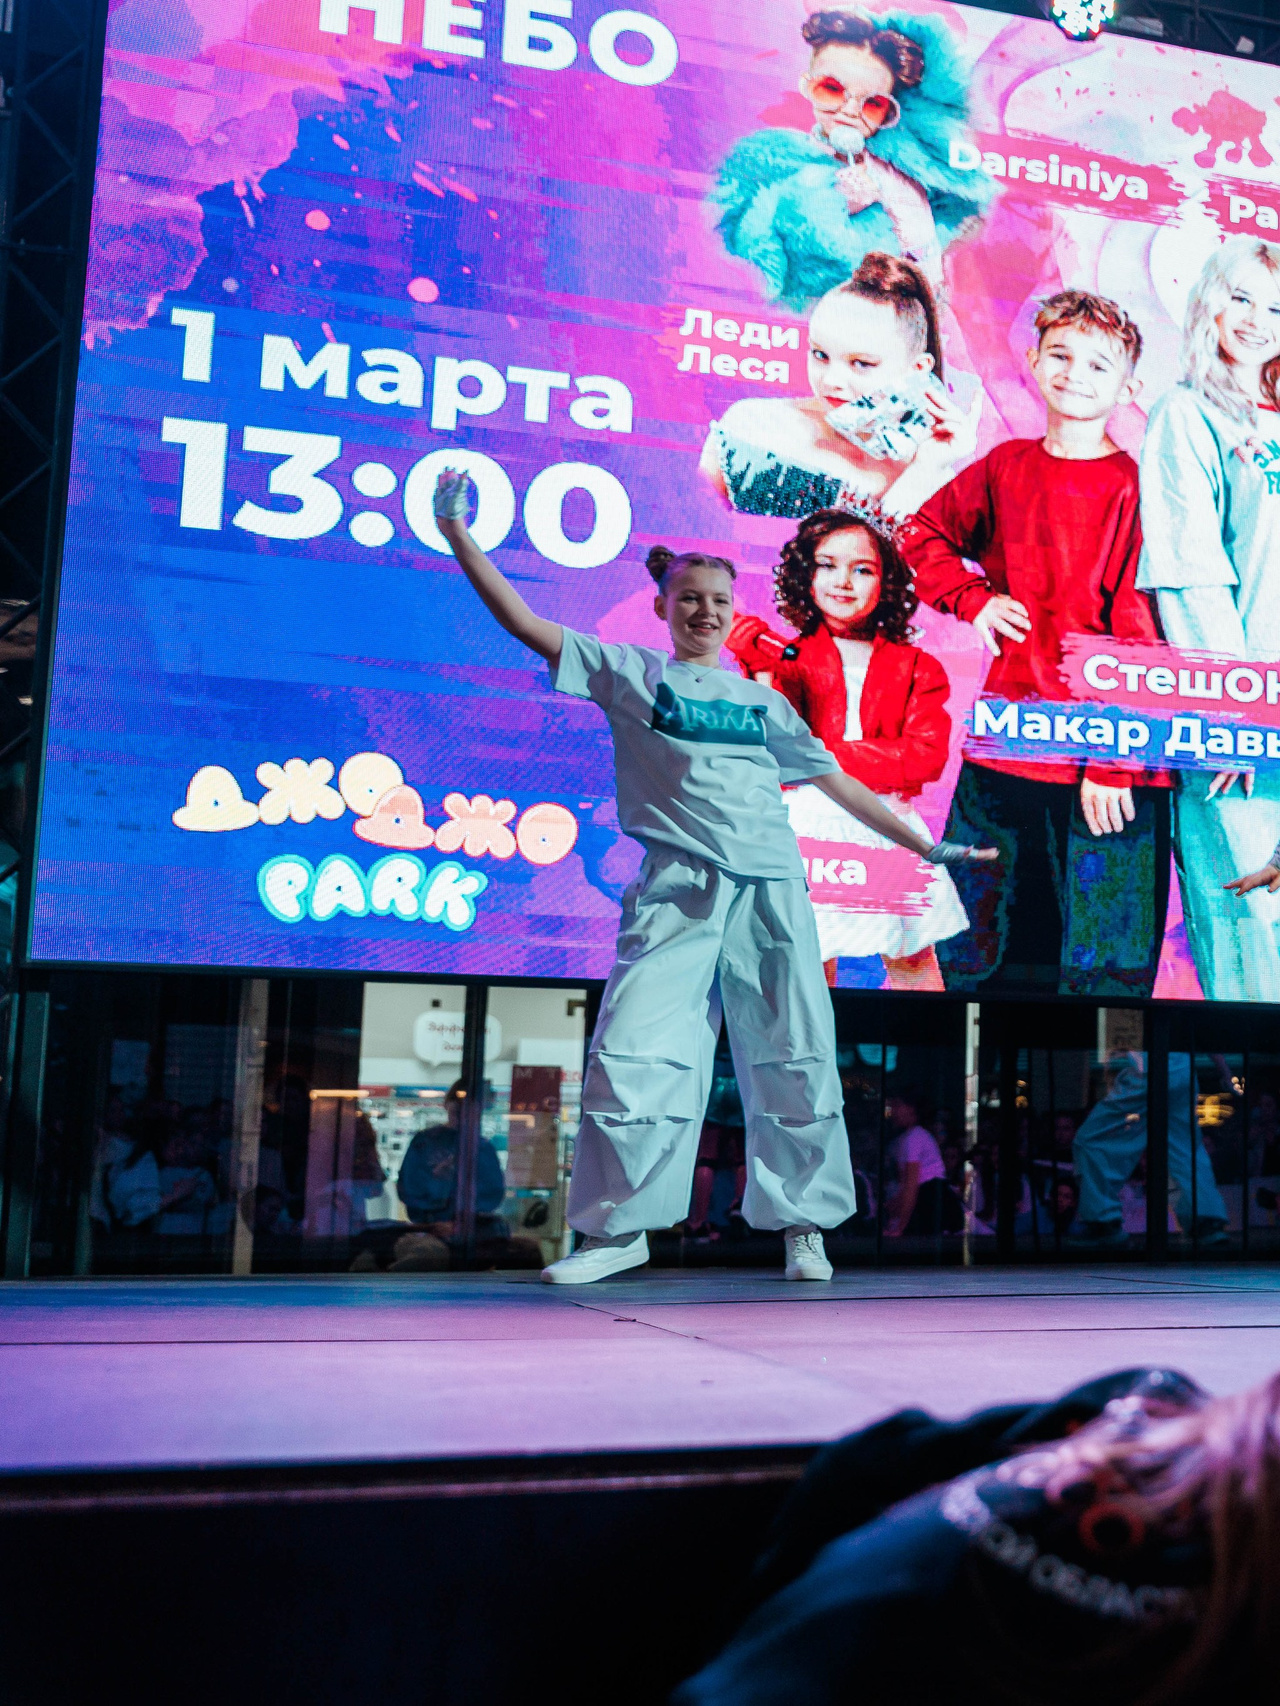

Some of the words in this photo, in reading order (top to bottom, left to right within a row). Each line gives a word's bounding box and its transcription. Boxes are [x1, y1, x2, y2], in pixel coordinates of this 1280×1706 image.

[948, 140, 1149, 201] Darsiniya
[678, 307, 800, 351] Леди
[170, 306, 216, 384] 1
[259, 332, 635, 433] марта
[676, 343, 790, 384] Леся
[160, 415, 634, 569] 13:00
[972, 699, 1151, 758] Макар
[256, 852, 489, 932] PARK
[801, 856, 868, 886] ка
